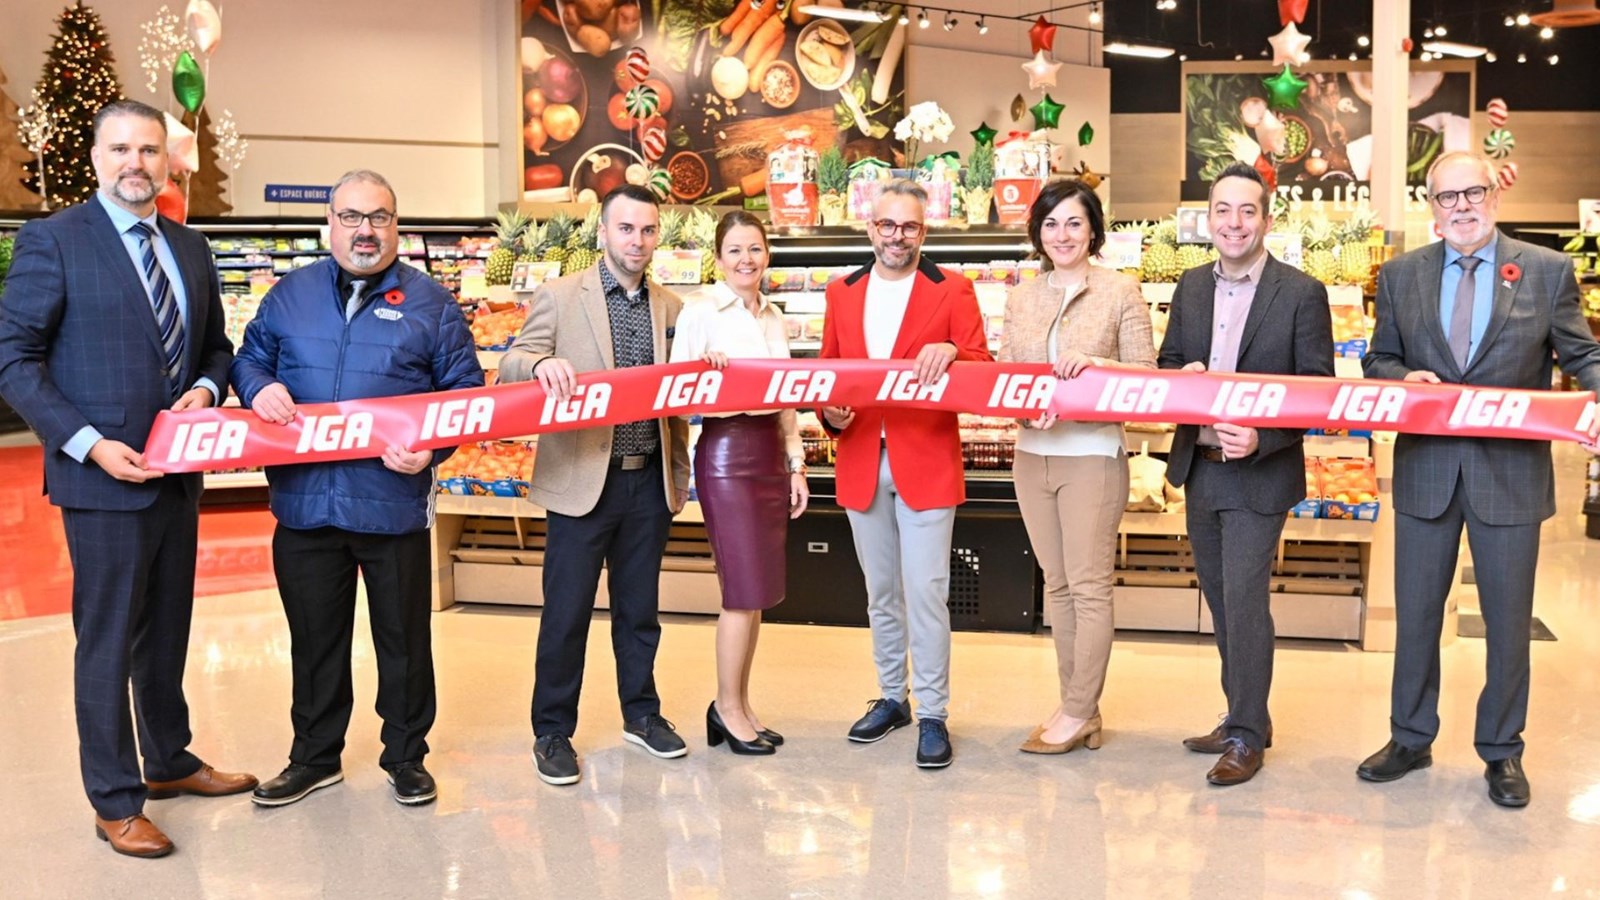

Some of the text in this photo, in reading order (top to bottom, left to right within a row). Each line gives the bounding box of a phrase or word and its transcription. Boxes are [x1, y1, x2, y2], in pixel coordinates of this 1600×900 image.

[280, 189, 327, 199] ESPACE QUÉBEC
[167, 420, 248, 463] IGA
[295, 412, 373, 454] IGA
[420, 397, 495, 440] IGA
[539, 382, 612, 425] IGA
[652, 370, 723, 410] IGA
[763, 370, 836, 403] IGA
[876, 370, 950, 402] IGA
[987, 373, 1057, 409] IGA
[1095, 377, 1169, 413] IGA
[1209, 380, 1287, 417] IGA
[1327, 385, 1403, 423] IGA
[1448, 389, 1531, 427] IGA
